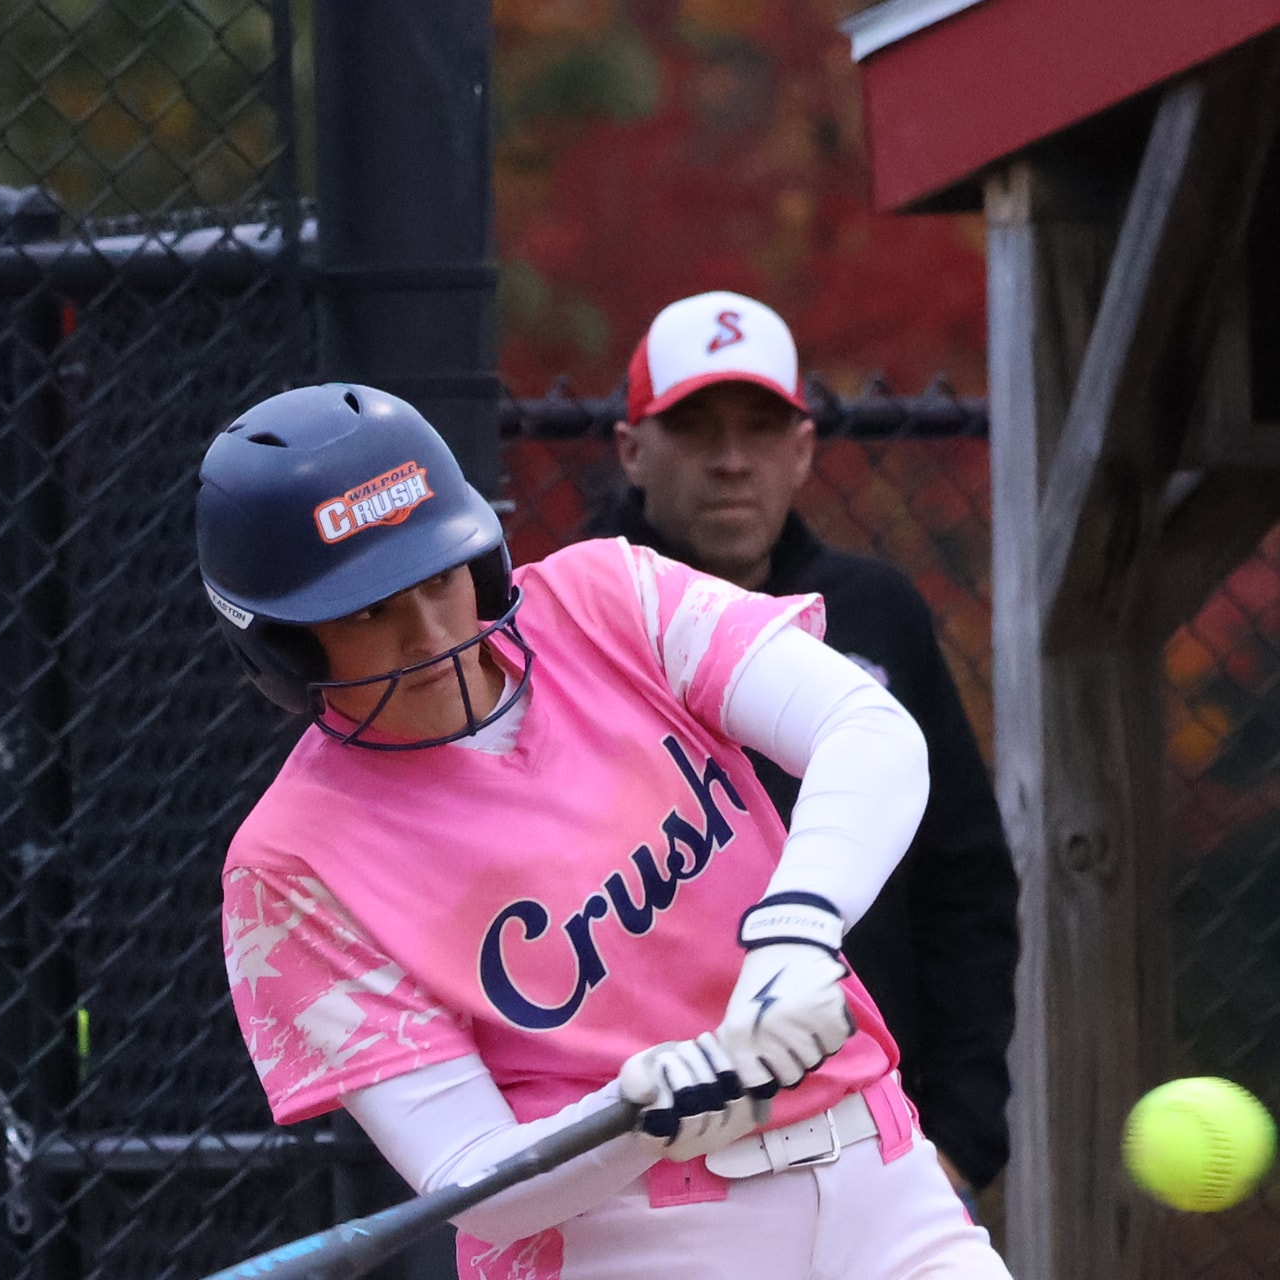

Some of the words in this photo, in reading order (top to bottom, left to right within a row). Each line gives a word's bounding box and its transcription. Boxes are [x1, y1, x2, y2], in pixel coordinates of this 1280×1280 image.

[318, 474, 427, 540] CRUSH
[348, 464, 416, 501] WALPOLE
[212, 595, 247, 622] EASTON
[478, 734, 748, 1030] Crush
